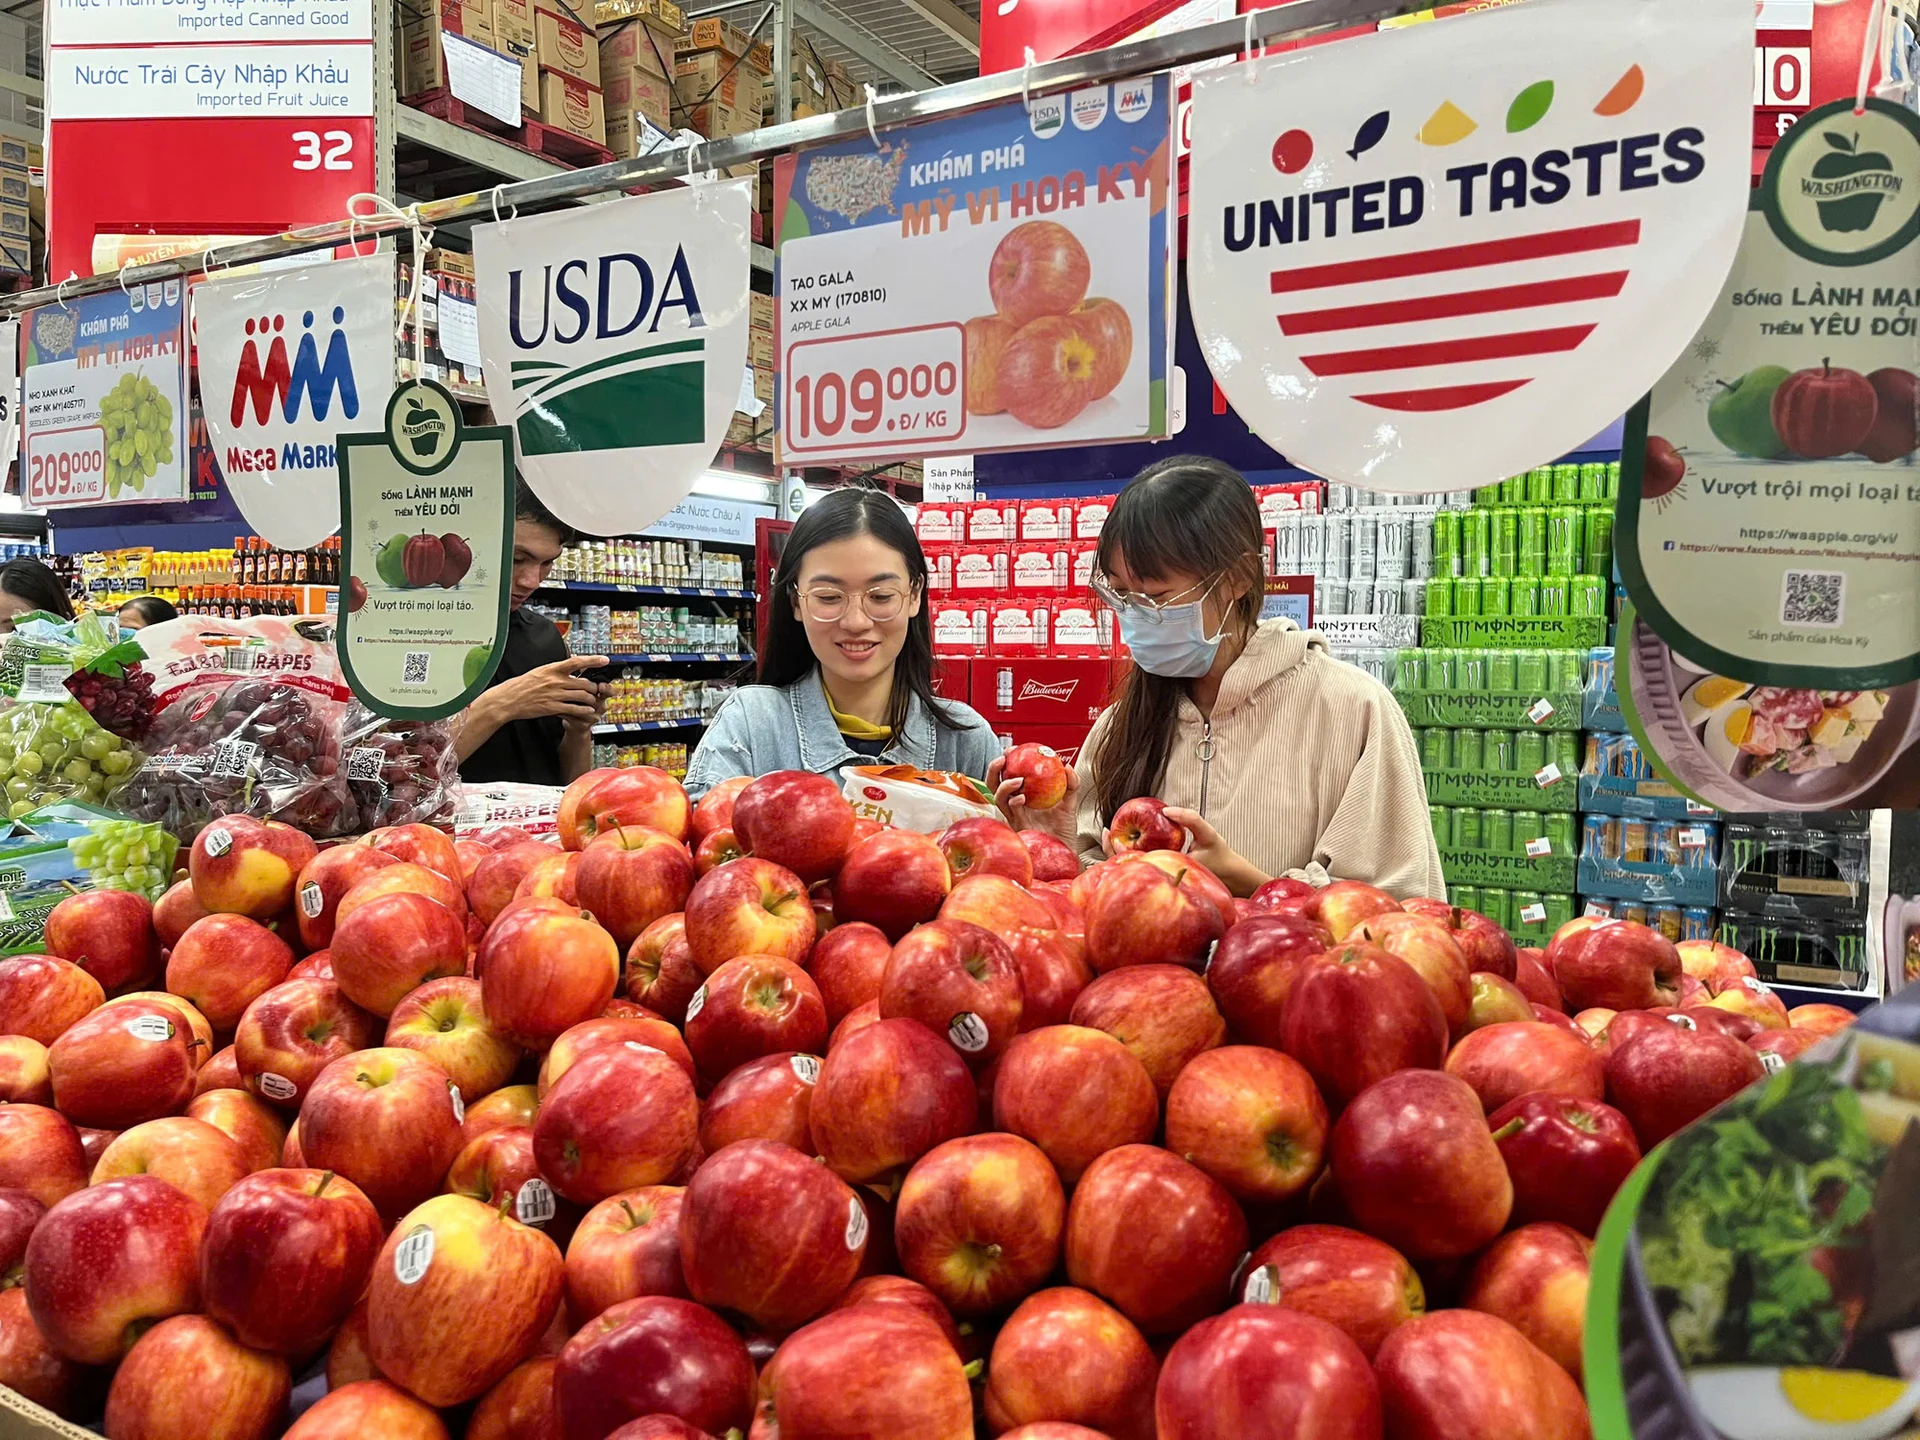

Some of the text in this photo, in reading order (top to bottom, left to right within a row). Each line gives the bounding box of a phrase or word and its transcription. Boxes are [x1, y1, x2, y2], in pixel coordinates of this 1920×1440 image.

[178, 11, 349, 31] Imported Canned Good
[75, 58, 349, 90] Nước Trái Cây Nhập Khẩu
[197, 92, 349, 110] Imported Fruit Juice
[1034, 106, 1060, 119] USDA
[292, 130, 354, 171] 32
[910, 135, 1026, 188] KHÁM PHÁ
[901, 187, 956, 238] MỸ
[1010, 170, 1086, 219] HOA
[1097, 146, 1152, 204] KỲ
[1223, 126, 1706, 253] UNITED TASTES
[1801, 173, 1903, 198] WASHINGTON
[791, 270, 855, 291] TAO GALA
[508, 241, 708, 350] USDA
[790, 288, 887, 313] XX MY (170810)
[1791, 281, 1864, 307] LÀNH
[1872, 287, 1920, 311] MẠ
[80, 309, 129, 338] KHÁM PHÁ
[791, 316, 851, 333] APPLE GALA
[1759, 309, 1918, 337] THÊM YÊU ĐỜI
[123, 335, 153, 362] HOA
[28, 390, 41, 400] NHO
[41, 388, 58, 398] XANH
[43, 403, 52, 413] NK
[401, 418, 447, 437] WASHINGTON
[925, 410, 947, 428] KG
[88, 481, 98, 492] KG
[406, 484, 437, 499] LÀNH
[439, 486, 473, 501] MẠNH
[928, 482, 952, 492] Nhập
[1701, 477, 1757, 500] Vượt
[1765, 479, 1802, 501] trội
[1809, 482, 1851, 502] mọi
[1859, 483, 1899, 504] loại
[394, 500, 460, 517] THÊM YÊU ĐỜI
[373, 600, 474, 613] Vượt trội mọi loại táo.
[1474, 618, 1565, 634] MONSTER
[1829, 634, 1853, 646] Hoa
[165, 658, 201, 677] Fresh
[255, 653, 313, 671] RAPES
[302, 677, 320, 691] Sans
[1025, 682, 1072, 696] Budweiser
[1443, 851, 1539, 871] MONSTER
[1460, 868, 1521, 878] ENERGY
[4, 920, 39, 935] SANS
